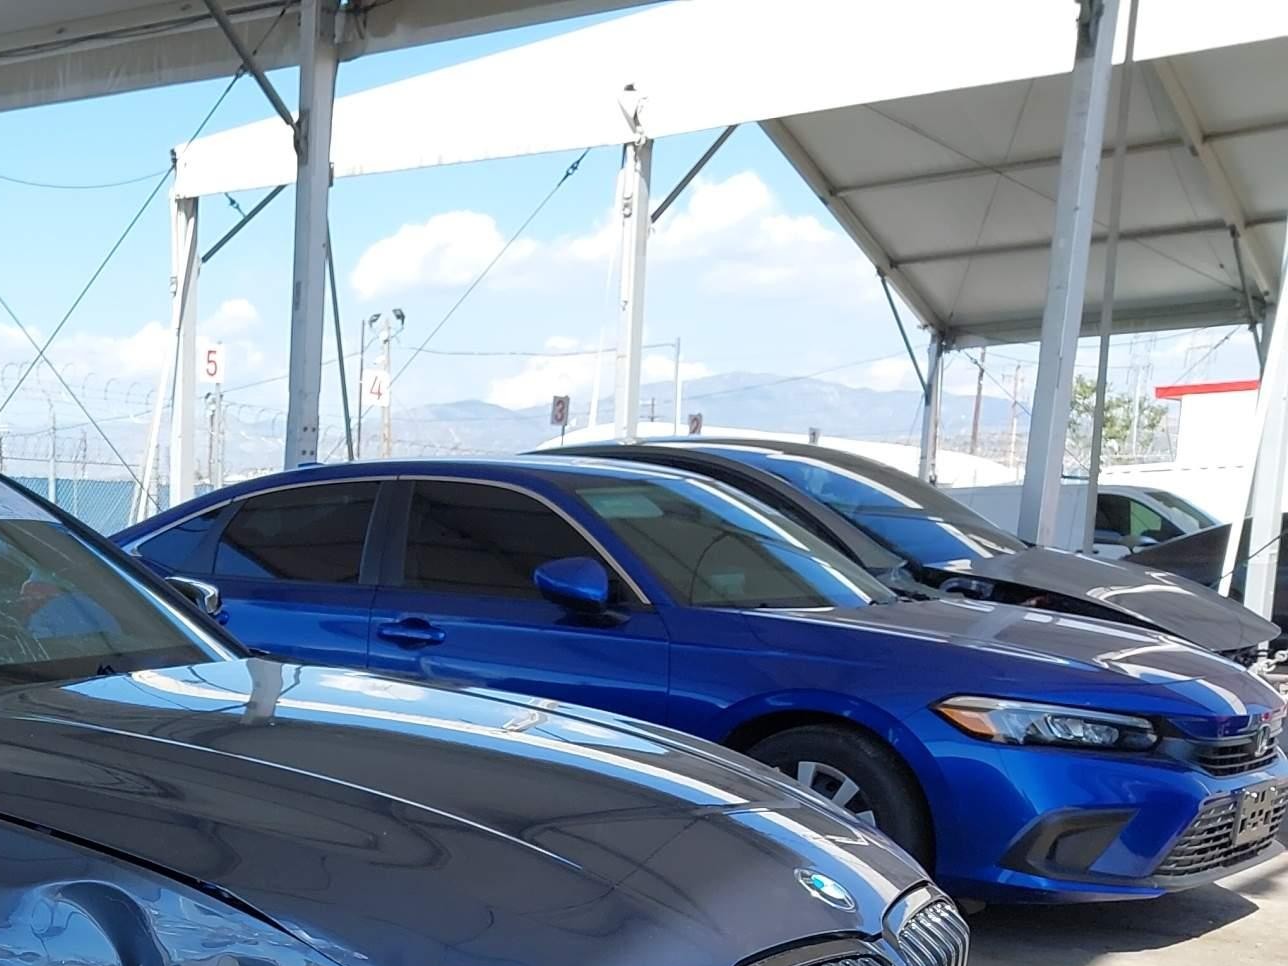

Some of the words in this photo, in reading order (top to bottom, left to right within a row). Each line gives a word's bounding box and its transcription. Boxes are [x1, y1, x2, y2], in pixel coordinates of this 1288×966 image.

[205, 350, 218, 377] 5
[369, 375, 383, 400] 4
[555, 399, 565, 422] 3
